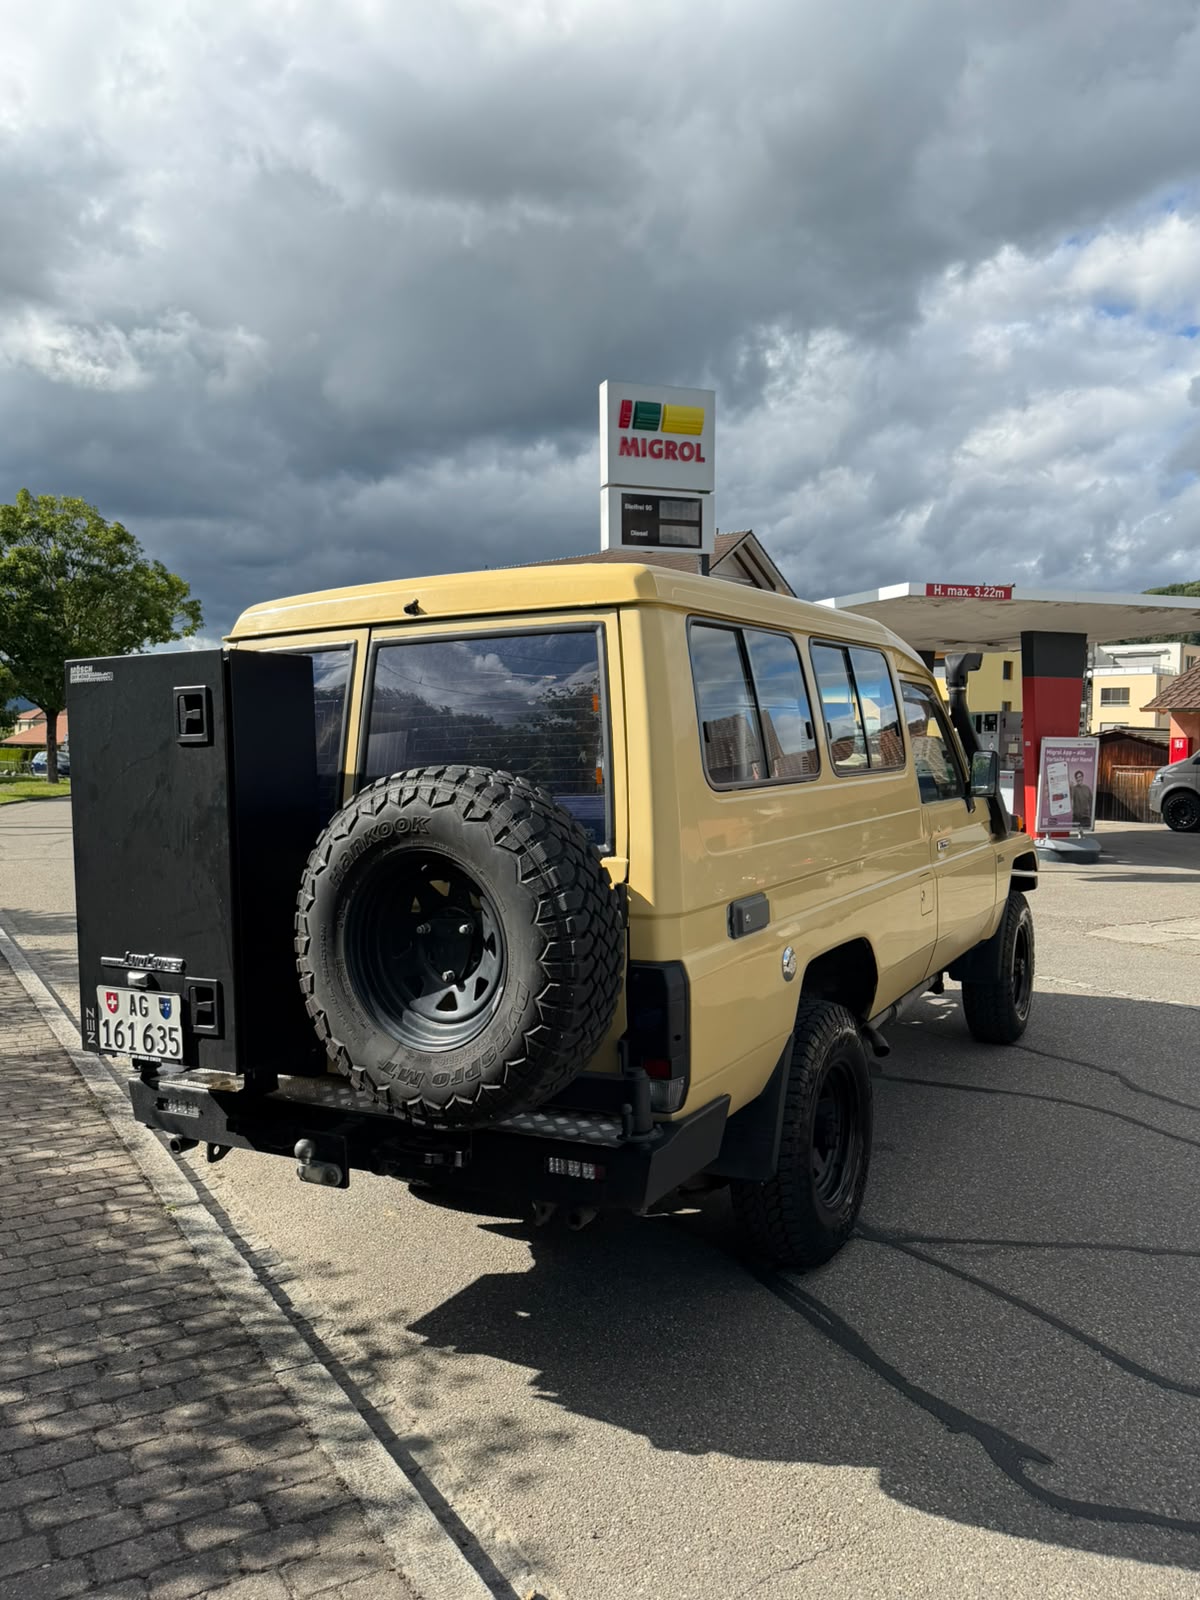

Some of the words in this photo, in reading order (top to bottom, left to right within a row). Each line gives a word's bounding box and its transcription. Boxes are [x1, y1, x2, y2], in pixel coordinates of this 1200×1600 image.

[618, 436, 706, 463] MIGROL
[934, 585, 944, 596] H.
[947, 587, 972, 597] max.
[974, 586, 1005, 598] 3.22m
[129, 994, 149, 1018] AG
[102, 1019, 137, 1051] 161
[143, 1023, 180, 1057] 635
[378, 1059, 426, 1089] MT
